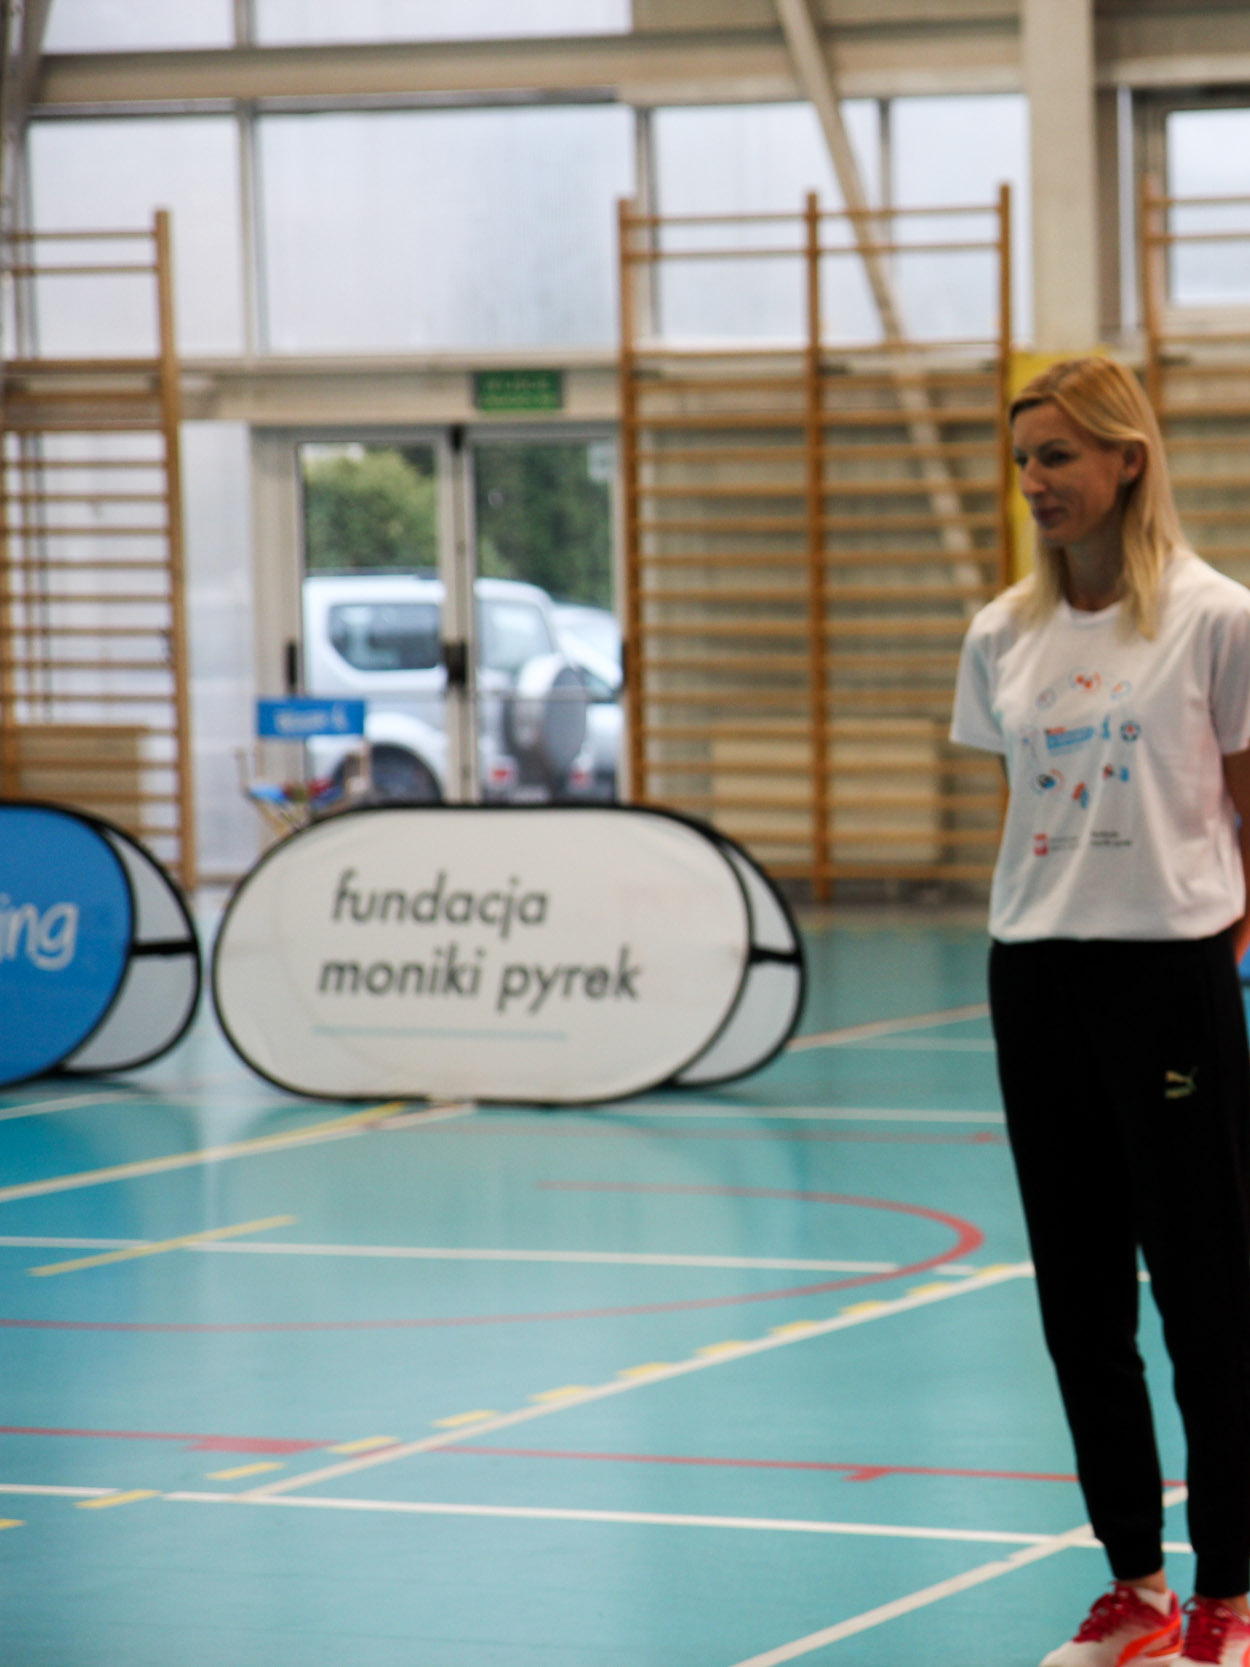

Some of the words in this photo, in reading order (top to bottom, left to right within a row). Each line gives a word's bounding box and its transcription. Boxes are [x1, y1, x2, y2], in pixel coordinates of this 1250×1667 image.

[332, 867, 549, 940] fundacja
[318, 943, 486, 997] moniki
[496, 944, 643, 1015] pyrek
